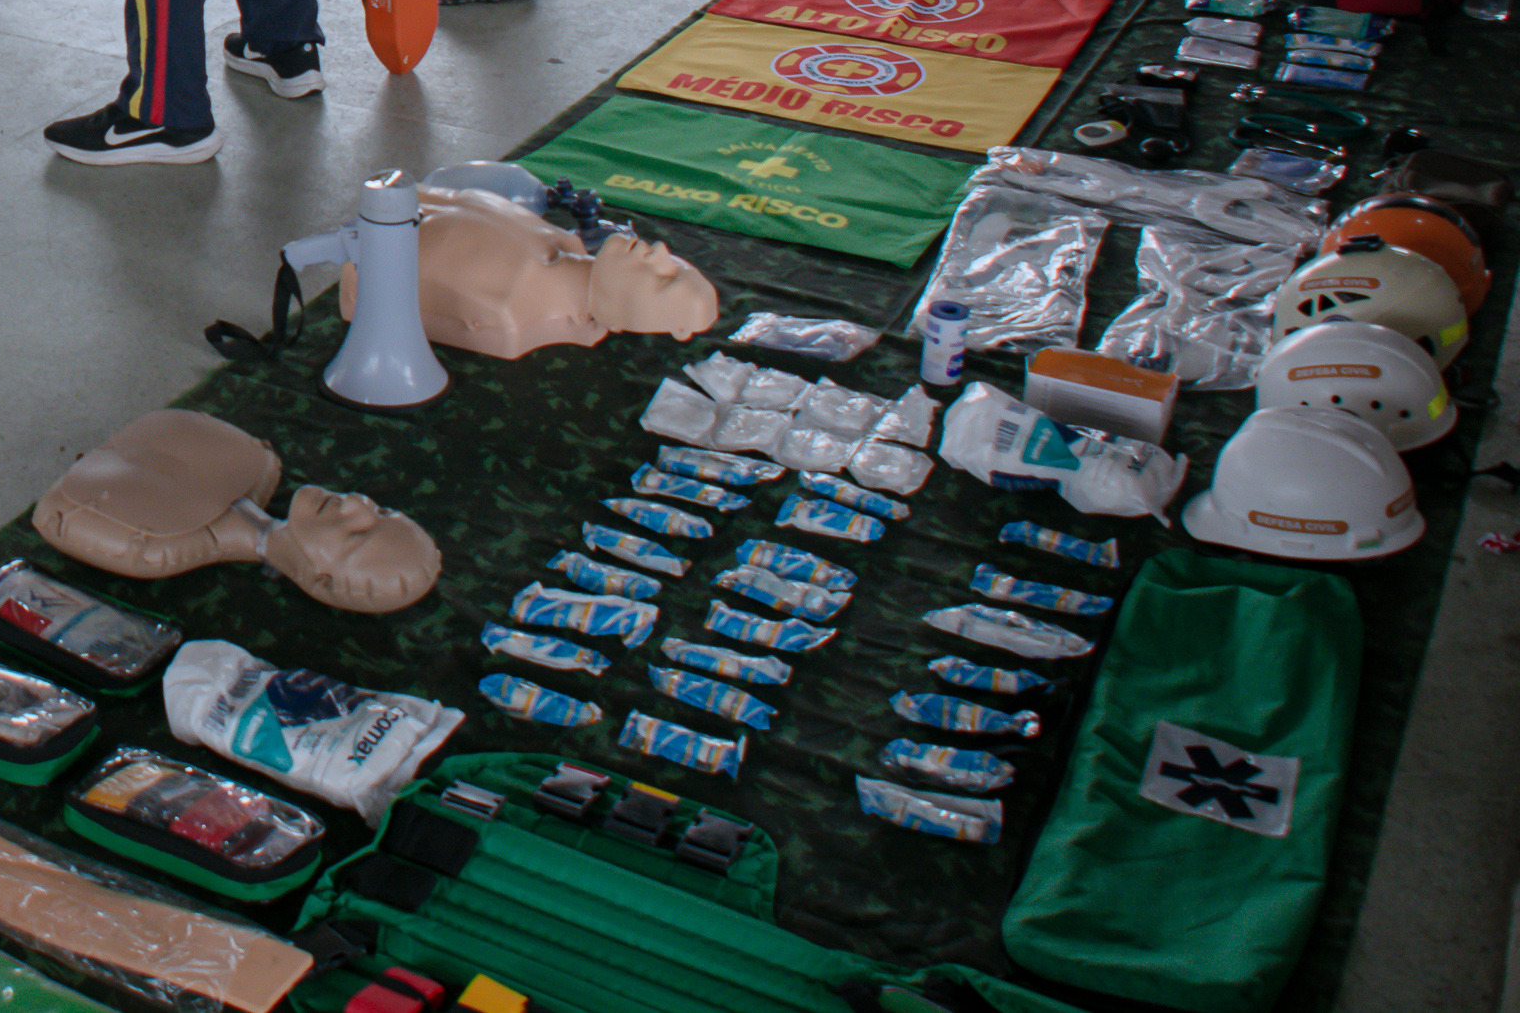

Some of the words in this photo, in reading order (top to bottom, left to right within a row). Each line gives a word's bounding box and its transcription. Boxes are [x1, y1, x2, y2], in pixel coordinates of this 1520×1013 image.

[764, 4, 869, 30] ALTO
[875, 14, 1008, 54] RISCO
[665, 72, 813, 111] MÉDIO
[819, 99, 966, 137] RISCO
[604, 173, 721, 203] BAIXO
[727, 193, 849, 229] RISCO
[1340, 366, 1372, 376] CIVIL
[1256, 513, 1302, 530] DEFESA
[1304, 521, 1339, 532] CIVIL
